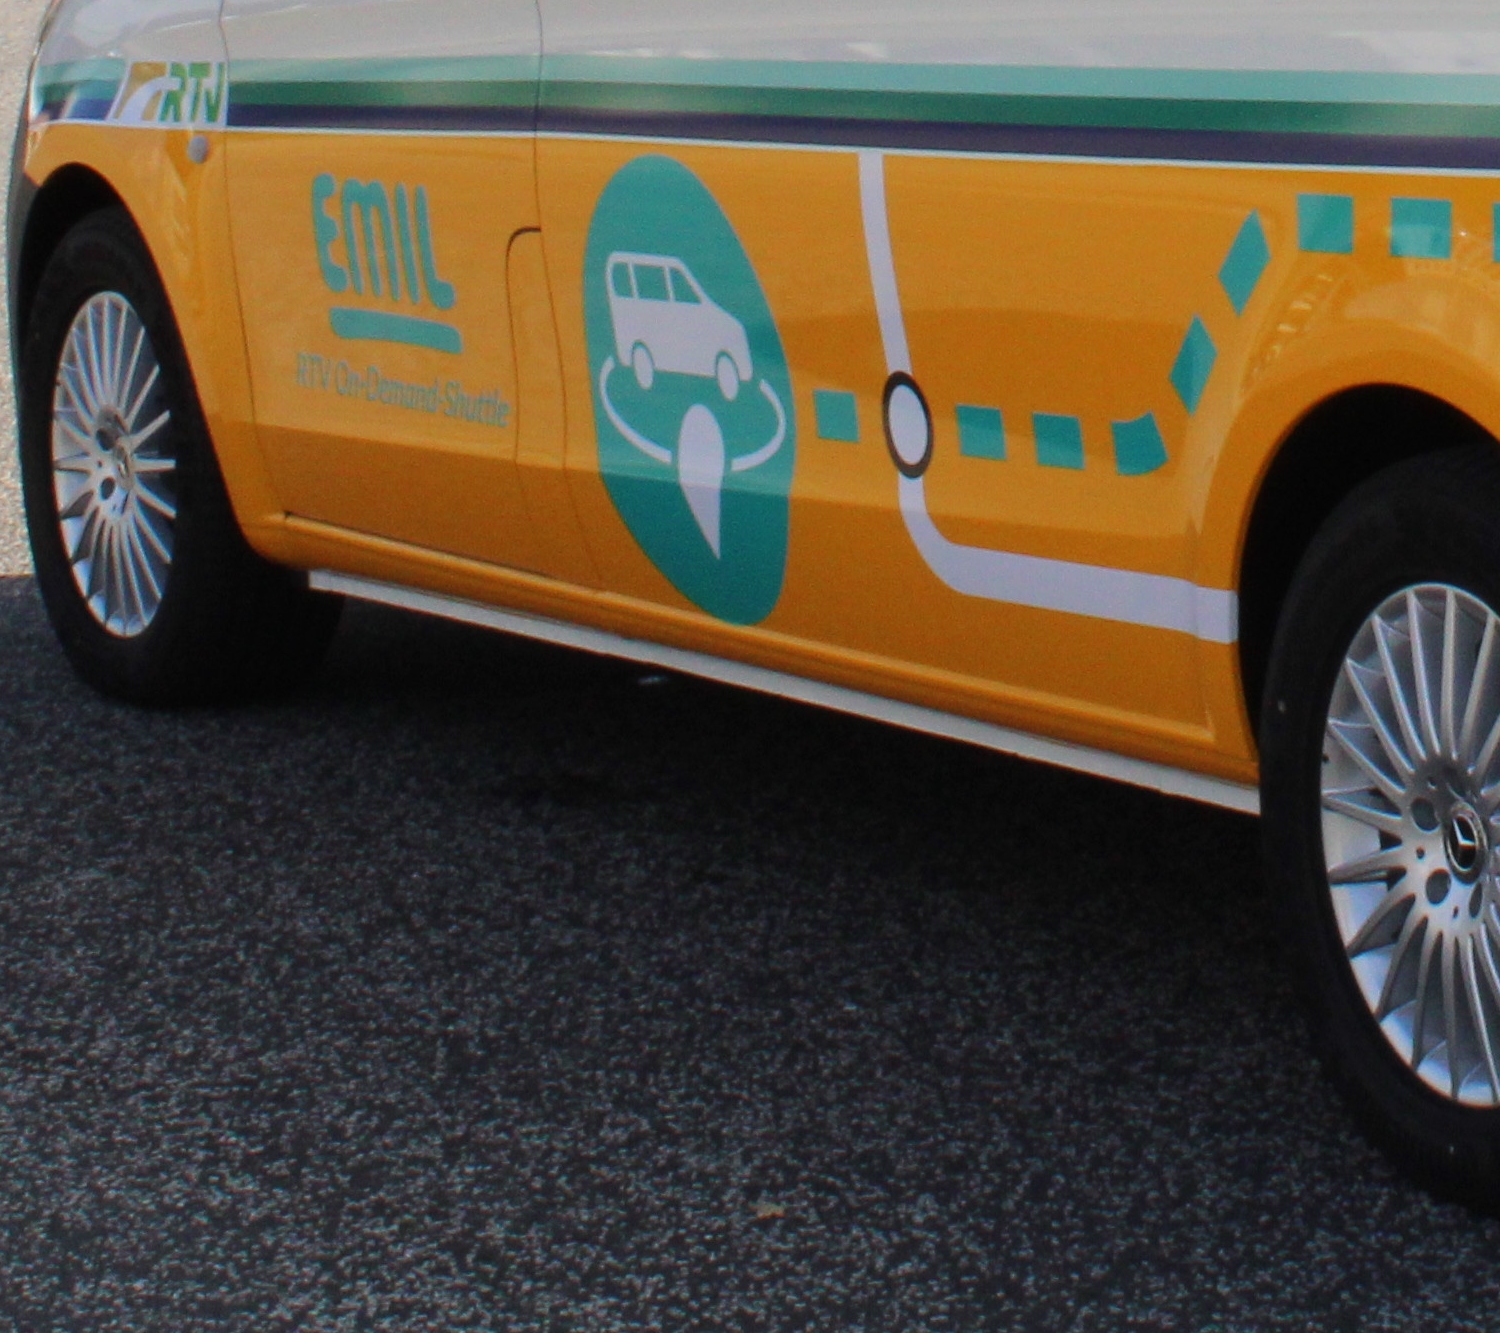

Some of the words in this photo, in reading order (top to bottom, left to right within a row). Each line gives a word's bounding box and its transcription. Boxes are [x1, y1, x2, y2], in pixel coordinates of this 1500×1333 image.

[158, 61, 225, 123] RTV
[311, 172, 458, 311] EMIL
[297, 351, 334, 392] RTV
[335, 359, 512, 428] On-Demand-Shuttle
